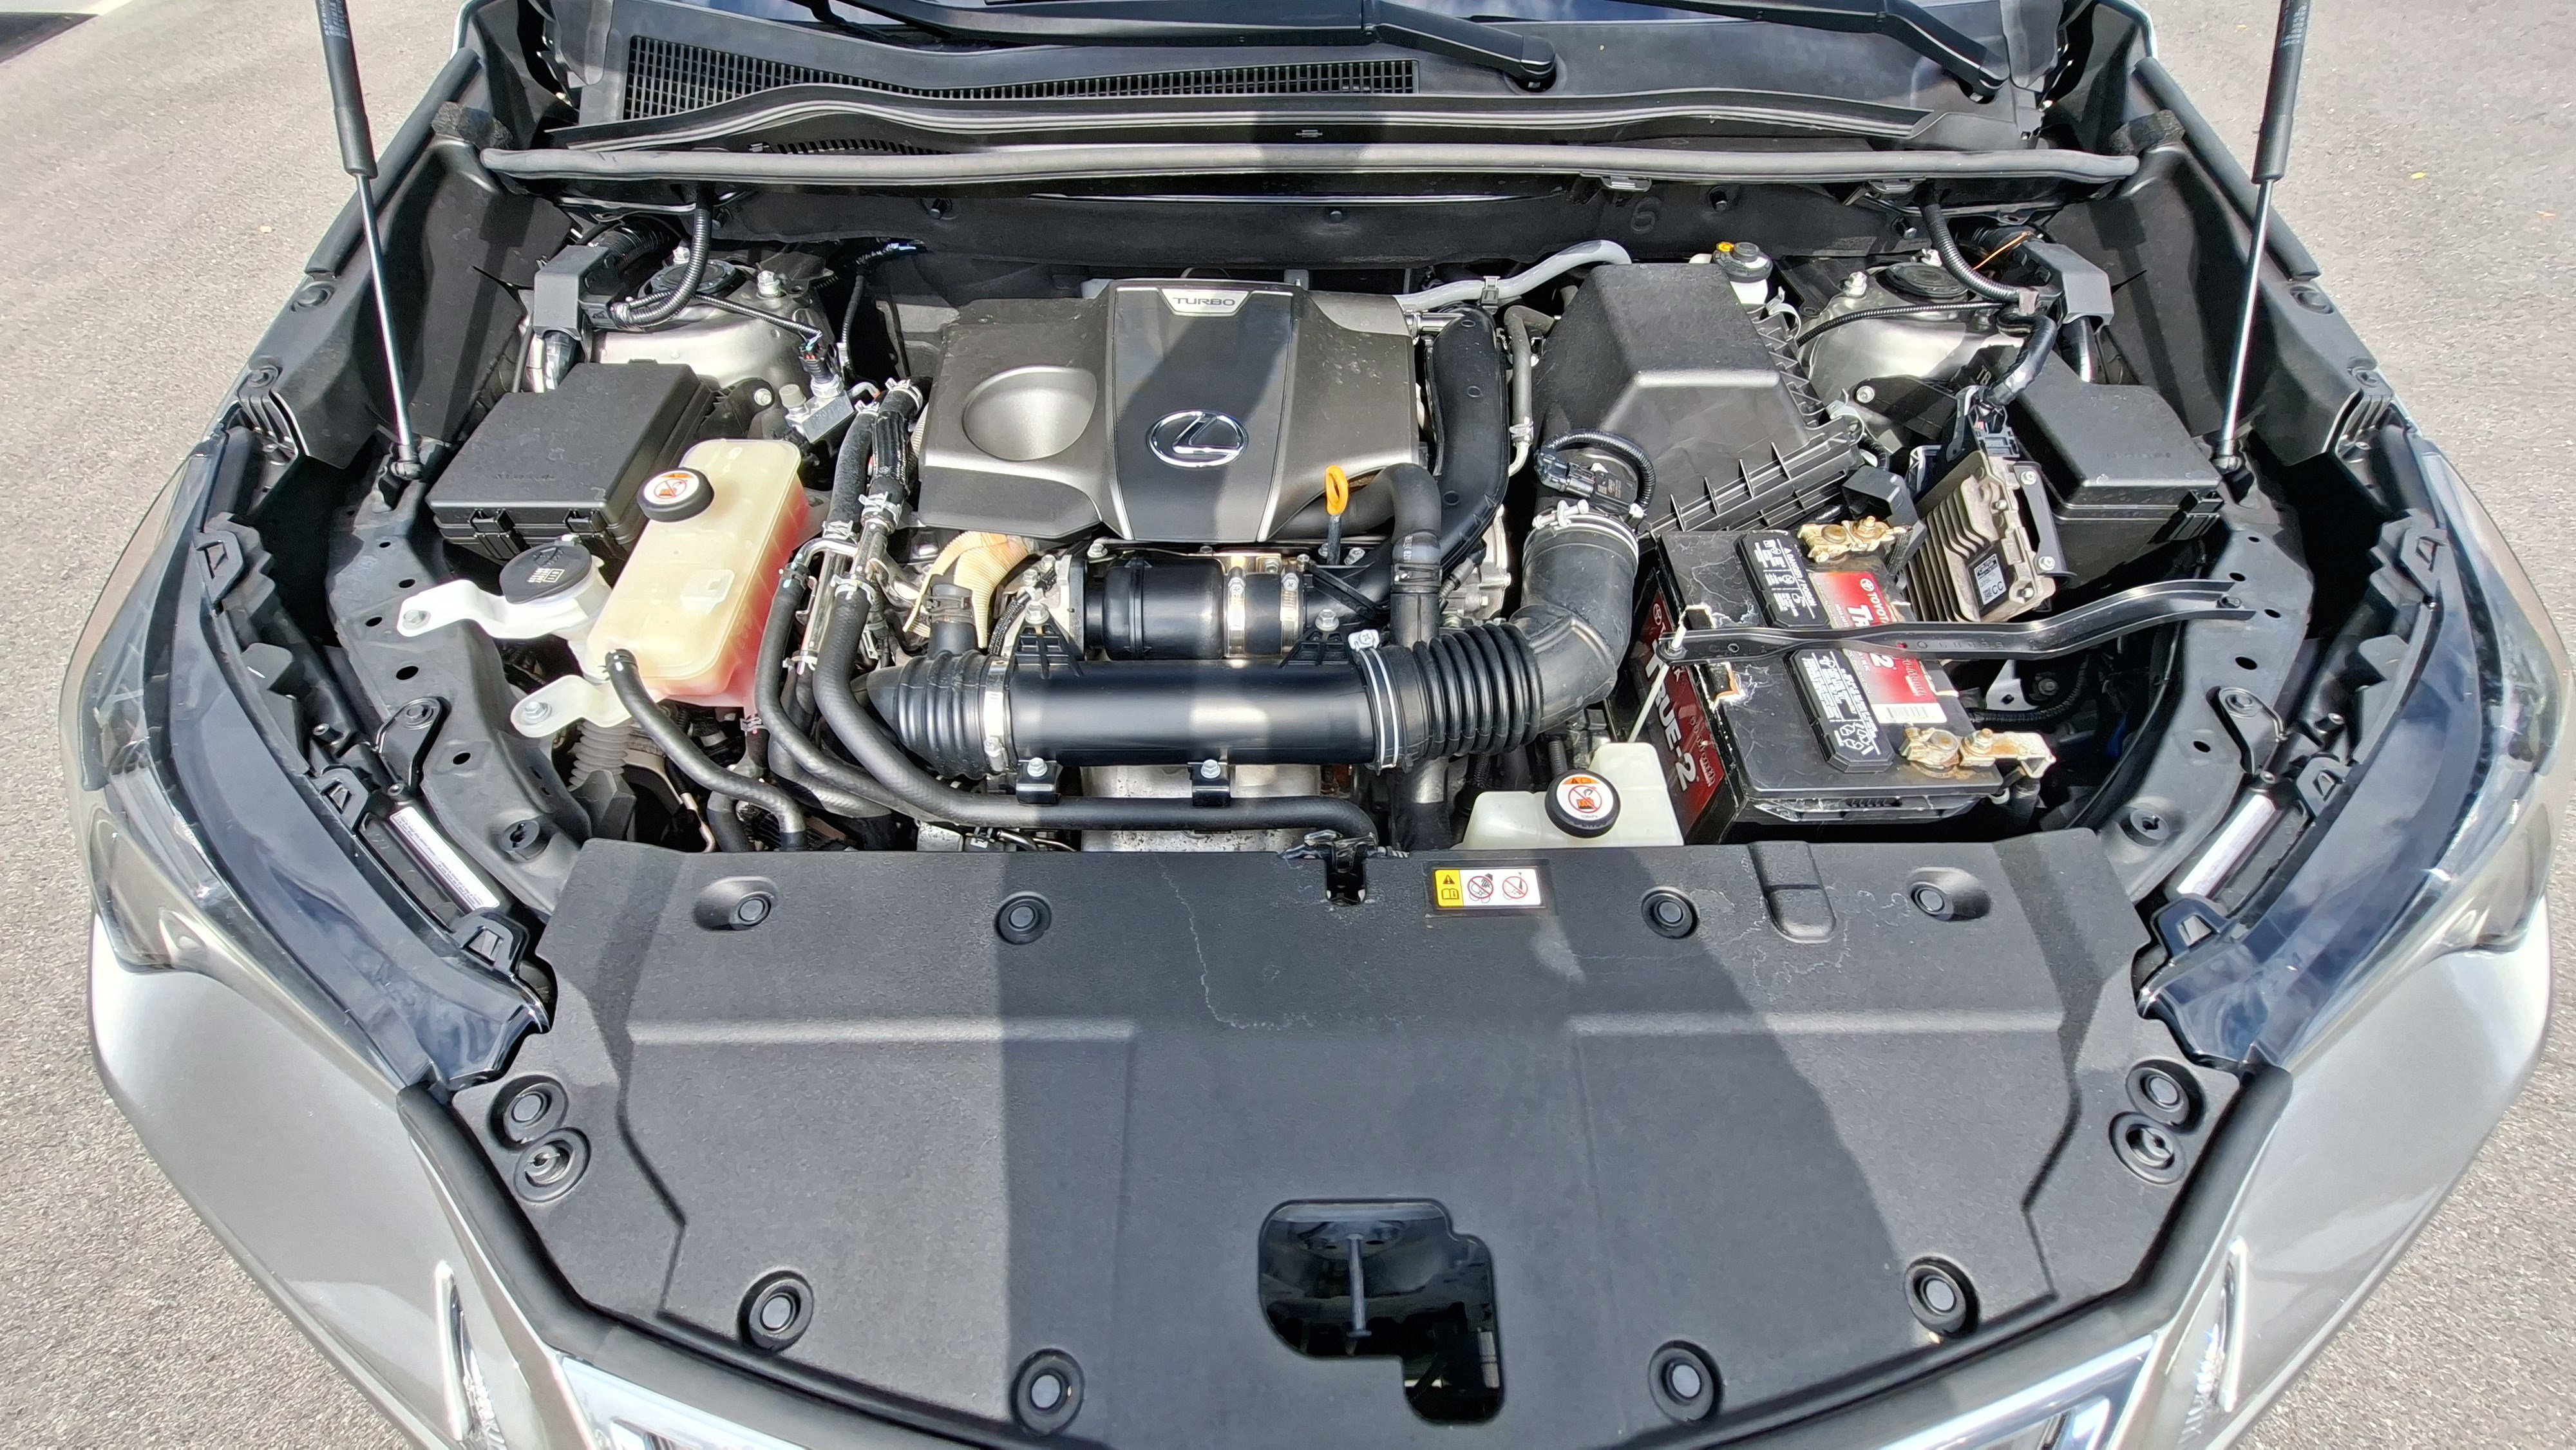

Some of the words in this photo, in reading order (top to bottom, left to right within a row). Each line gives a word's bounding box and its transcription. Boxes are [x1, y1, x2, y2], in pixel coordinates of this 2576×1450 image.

[1172, 297, 1236, 306] TURBO
[1787, 554, 1803, 580] DANGER
[1799, 582, 1817, 607] POISON
[1991, 581, 2004, 595] CC
